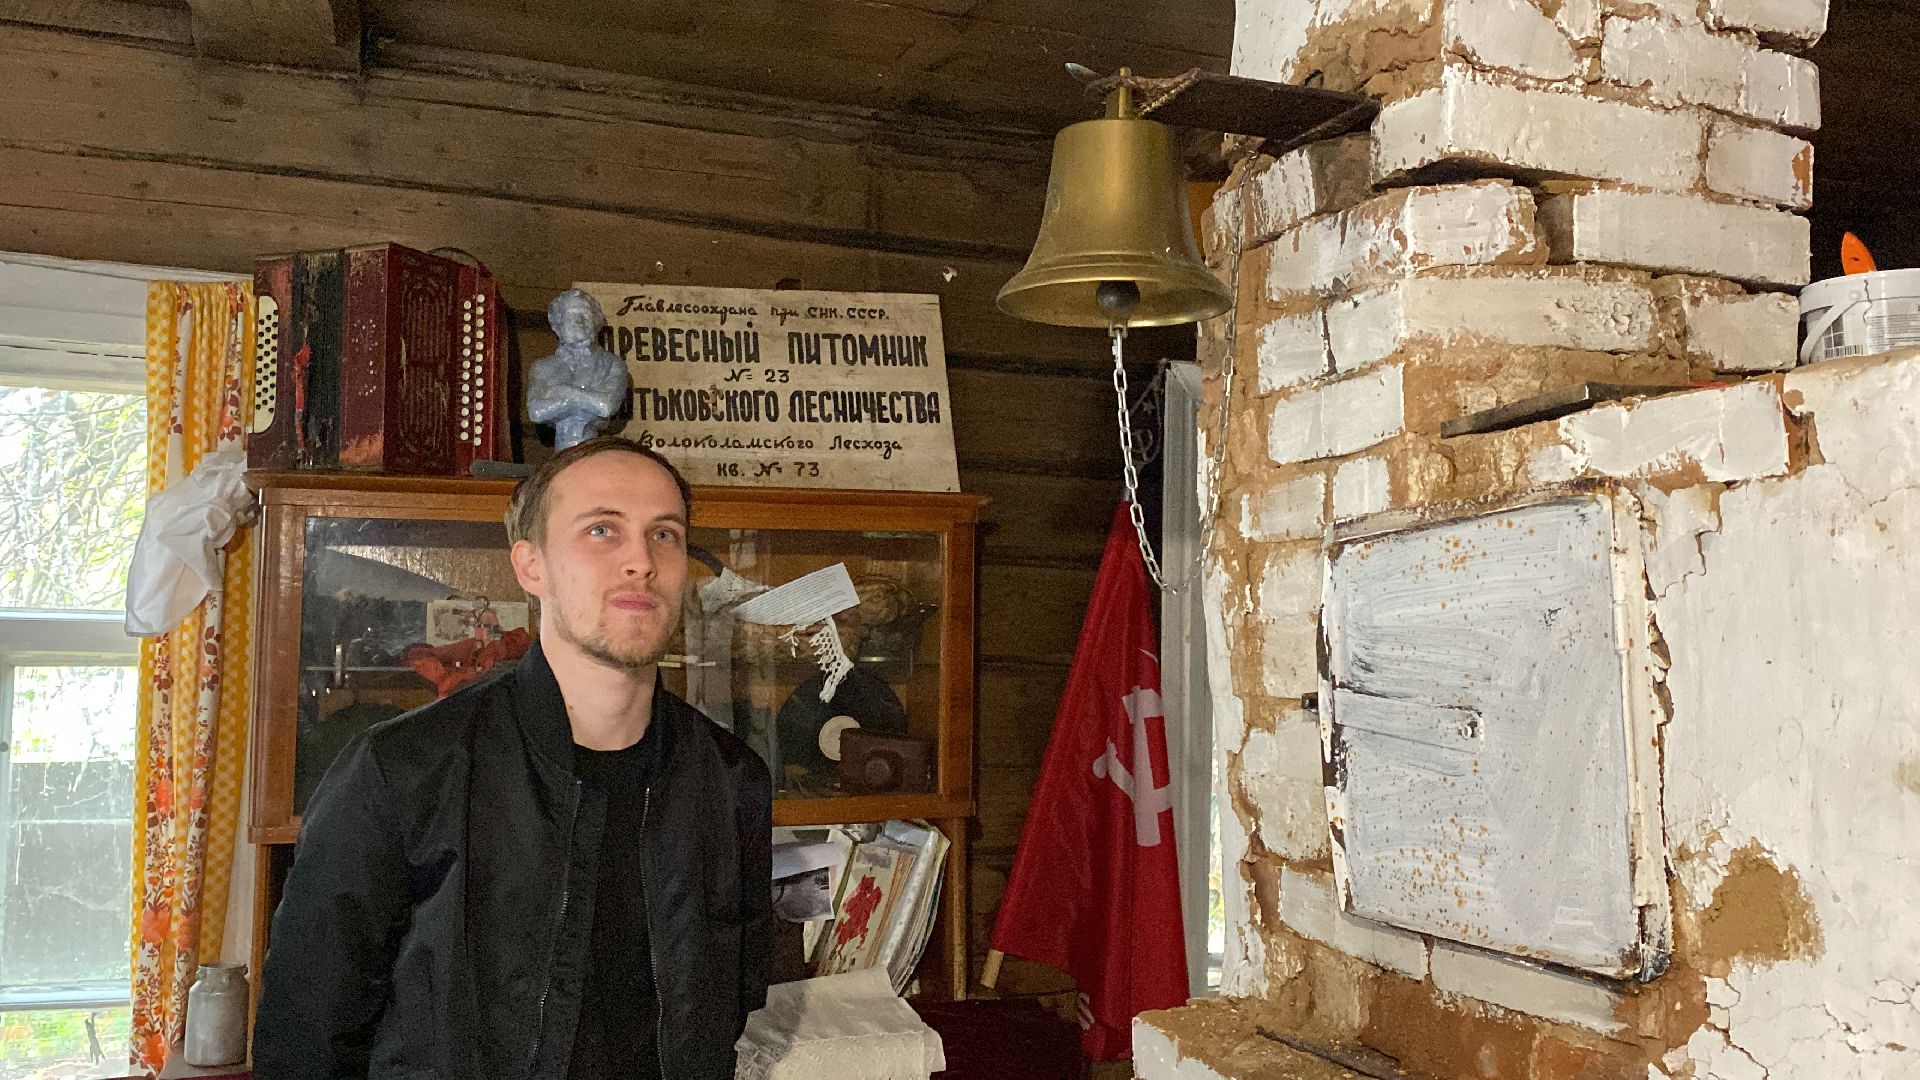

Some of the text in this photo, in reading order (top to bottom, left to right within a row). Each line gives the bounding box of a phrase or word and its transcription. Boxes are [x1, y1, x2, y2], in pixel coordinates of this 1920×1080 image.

[770, 306, 800, 327] при
[787, 331, 929, 367] ПИТОМНИК
[764, 368, 790, 384] 23
[788, 390, 941, 424] ЛЕСНИЧЕСТВА
[638, 430, 903, 460] Волоколамского Лесхоза
[793, 461, 820, 478] 73
